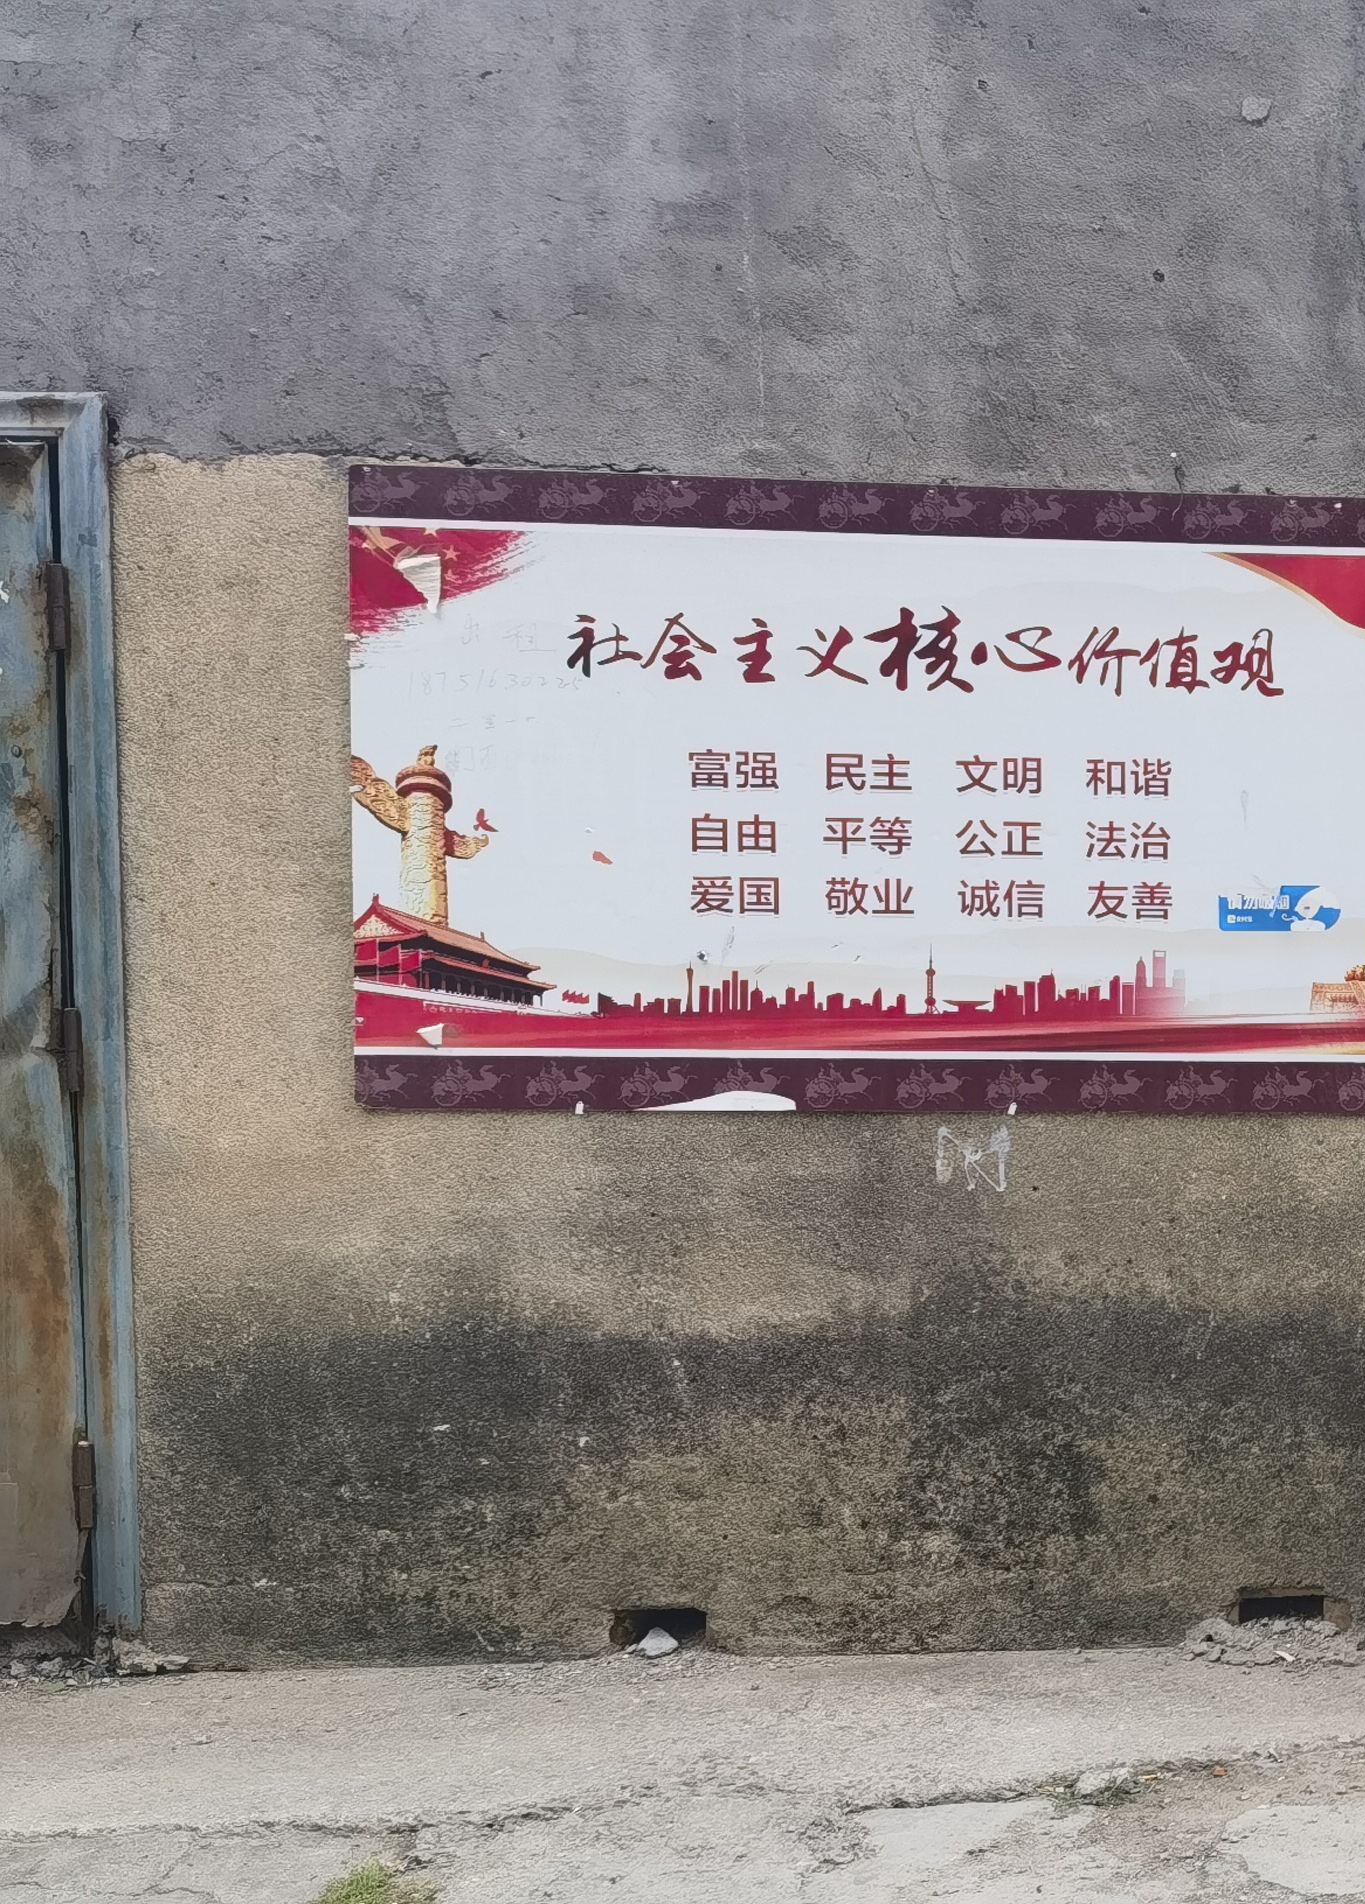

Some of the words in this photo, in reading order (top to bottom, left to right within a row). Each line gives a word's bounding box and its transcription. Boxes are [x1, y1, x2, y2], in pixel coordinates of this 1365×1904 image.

[566, 605, 1285, 698] 社会主义核心价值观
[688, 748, 779, 790] 富强
[825, 753, 912, 792] 民主
[955, 754, 1043, 795] 文明
[1085, 757, 1172, 797] 和谐
[691, 812, 778, 854] 自由
[822, 816, 913, 856] 平等
[955, 819, 1044, 857] 公正
[1085, 820, 1171, 861] 法治
[690, 875, 780, 916] 爱国
[824, 876, 915, 916] 敬业
[957, 879, 1046, 919] 诚信
[1087, 880, 1173, 921] 友善
